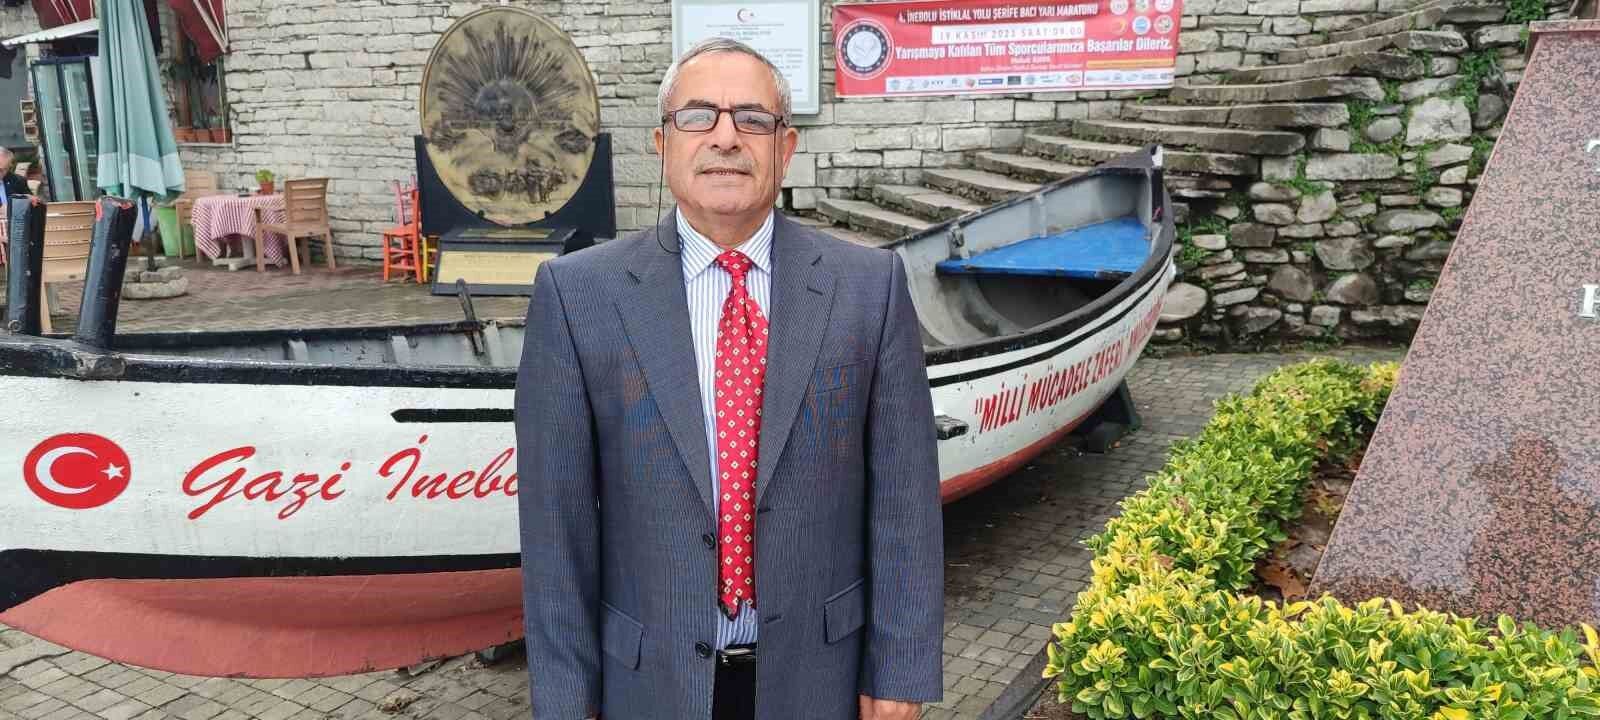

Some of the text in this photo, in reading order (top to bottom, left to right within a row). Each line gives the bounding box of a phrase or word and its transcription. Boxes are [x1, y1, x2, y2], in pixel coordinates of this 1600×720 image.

[940, 8, 972, 21] İSTİKLAL
[973, 7, 992, 19] YOLU
[993, 5, 1018, 20] ŞERİFE
[1019, 5, 1037, 17] BACI
[1038, 4, 1056, 17] YARI
[1057, 3, 1099, 16] MARATONU
[984, 43, 1004, 56] Tüm
[1026, 357, 1091, 416] MÜCADELE
[181, 445, 351, 520] Gazi
